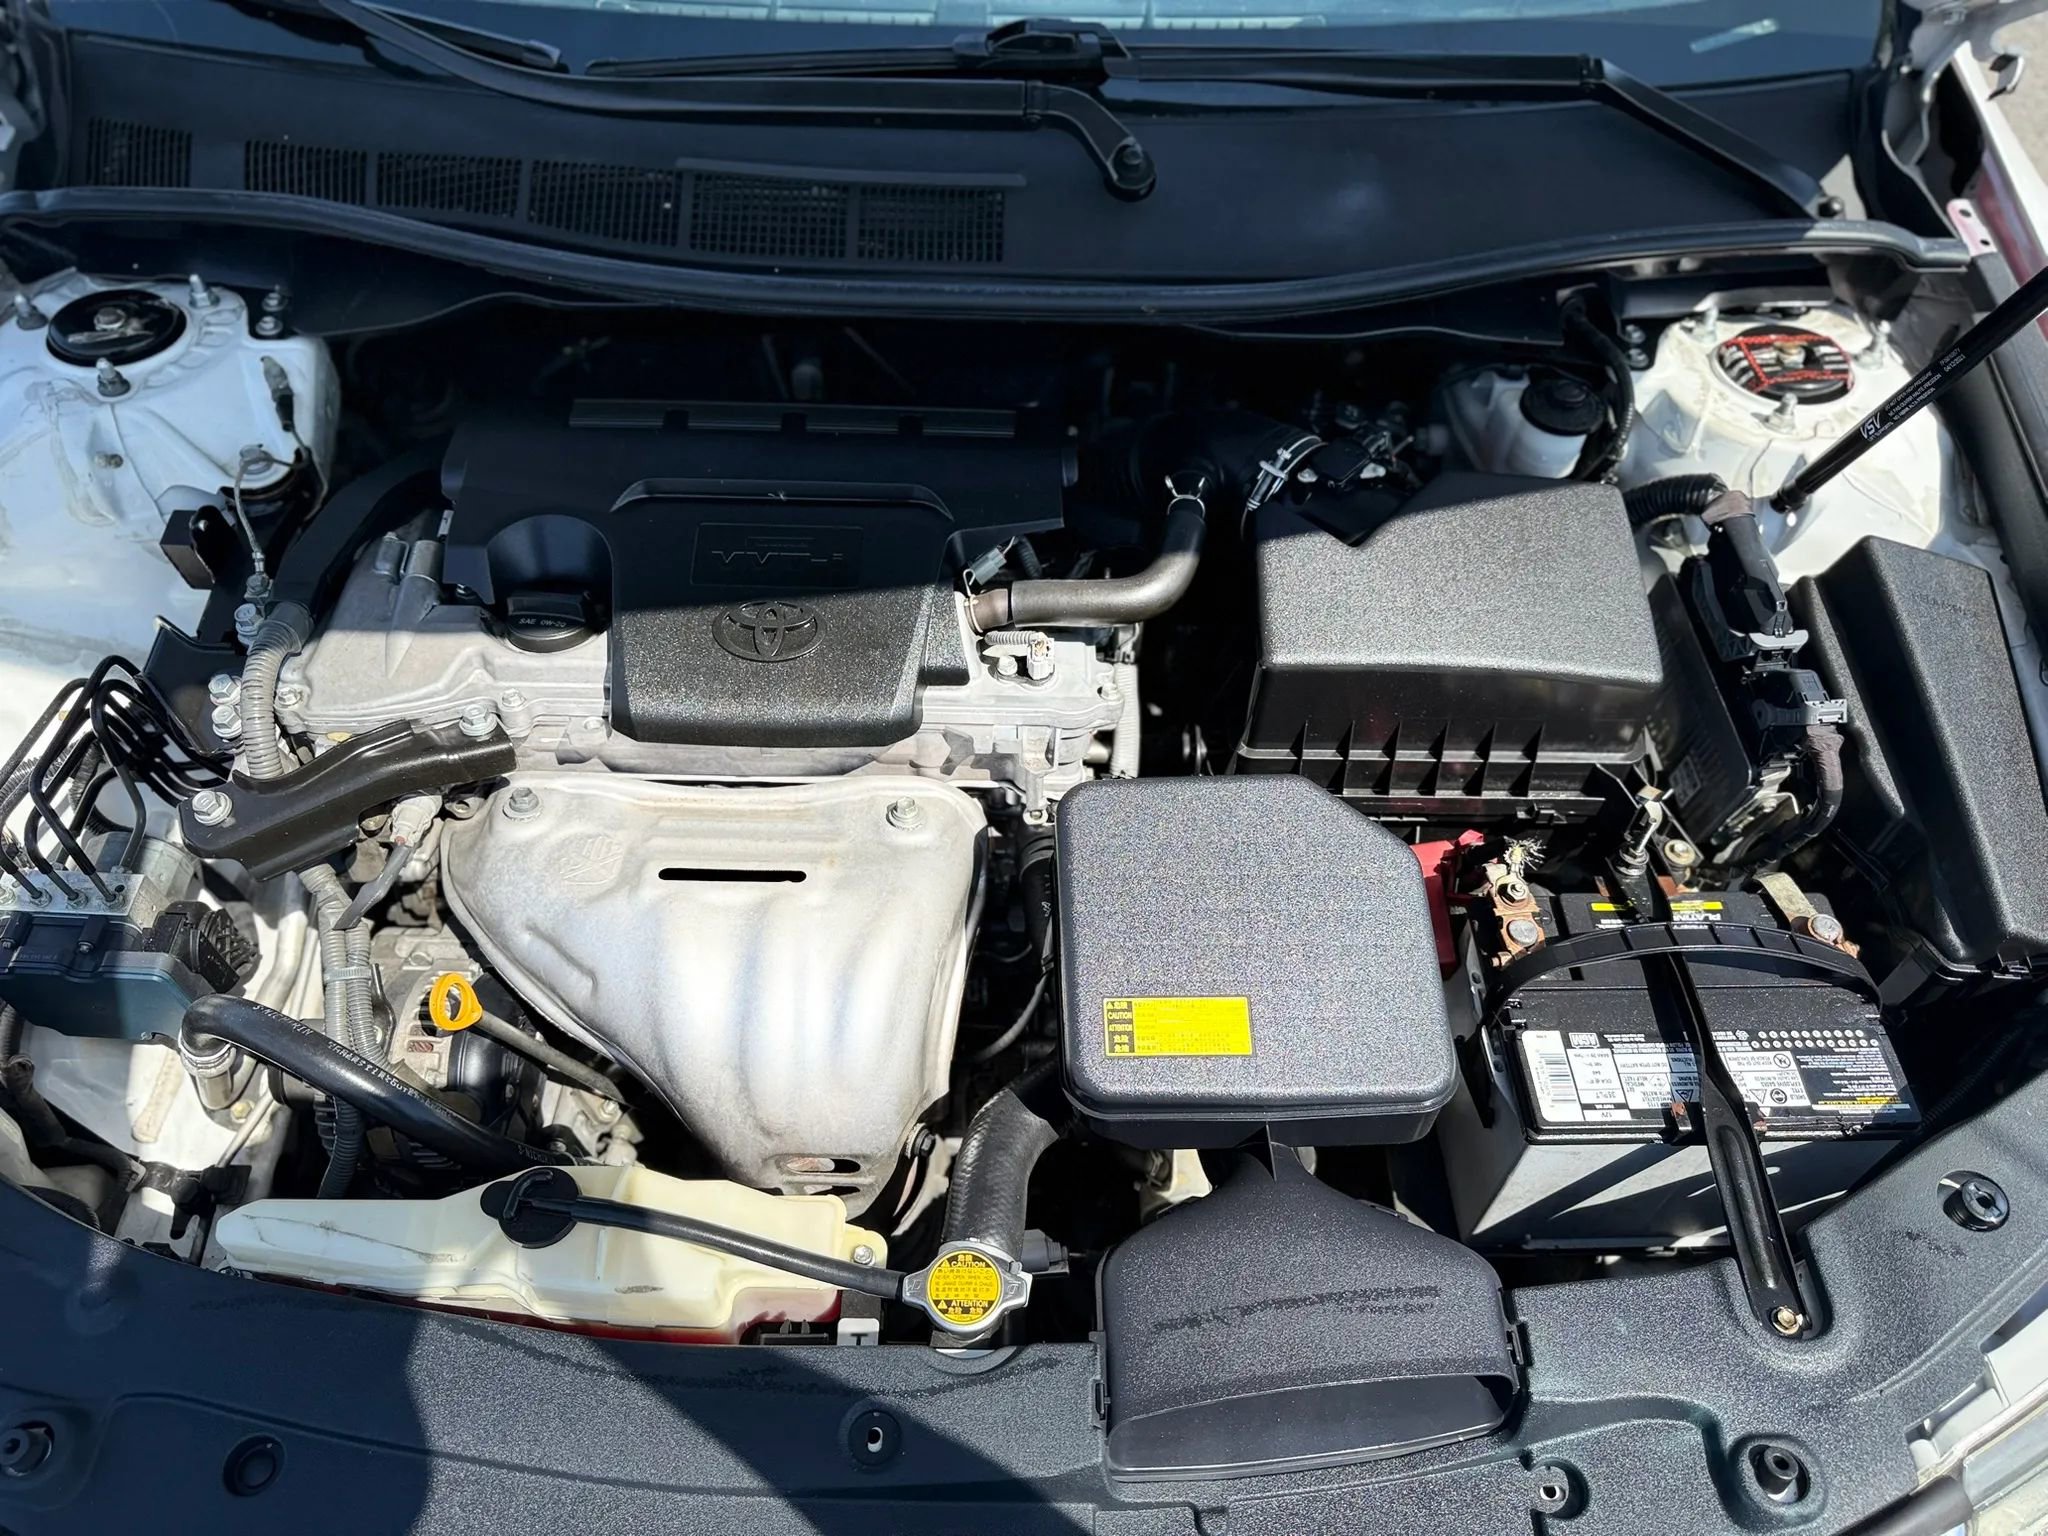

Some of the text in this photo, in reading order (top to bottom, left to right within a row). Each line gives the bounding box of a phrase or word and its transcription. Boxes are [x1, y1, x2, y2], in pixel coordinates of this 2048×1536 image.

[1860, 412, 1880, 439] VSV
[540, 619, 567, 628] 0W-20
[1108, 1012, 1132, 1020] CAUTION
[1571, 1034, 1598, 1046] AGM
[951, 1300, 988, 1308] ATTENTION
